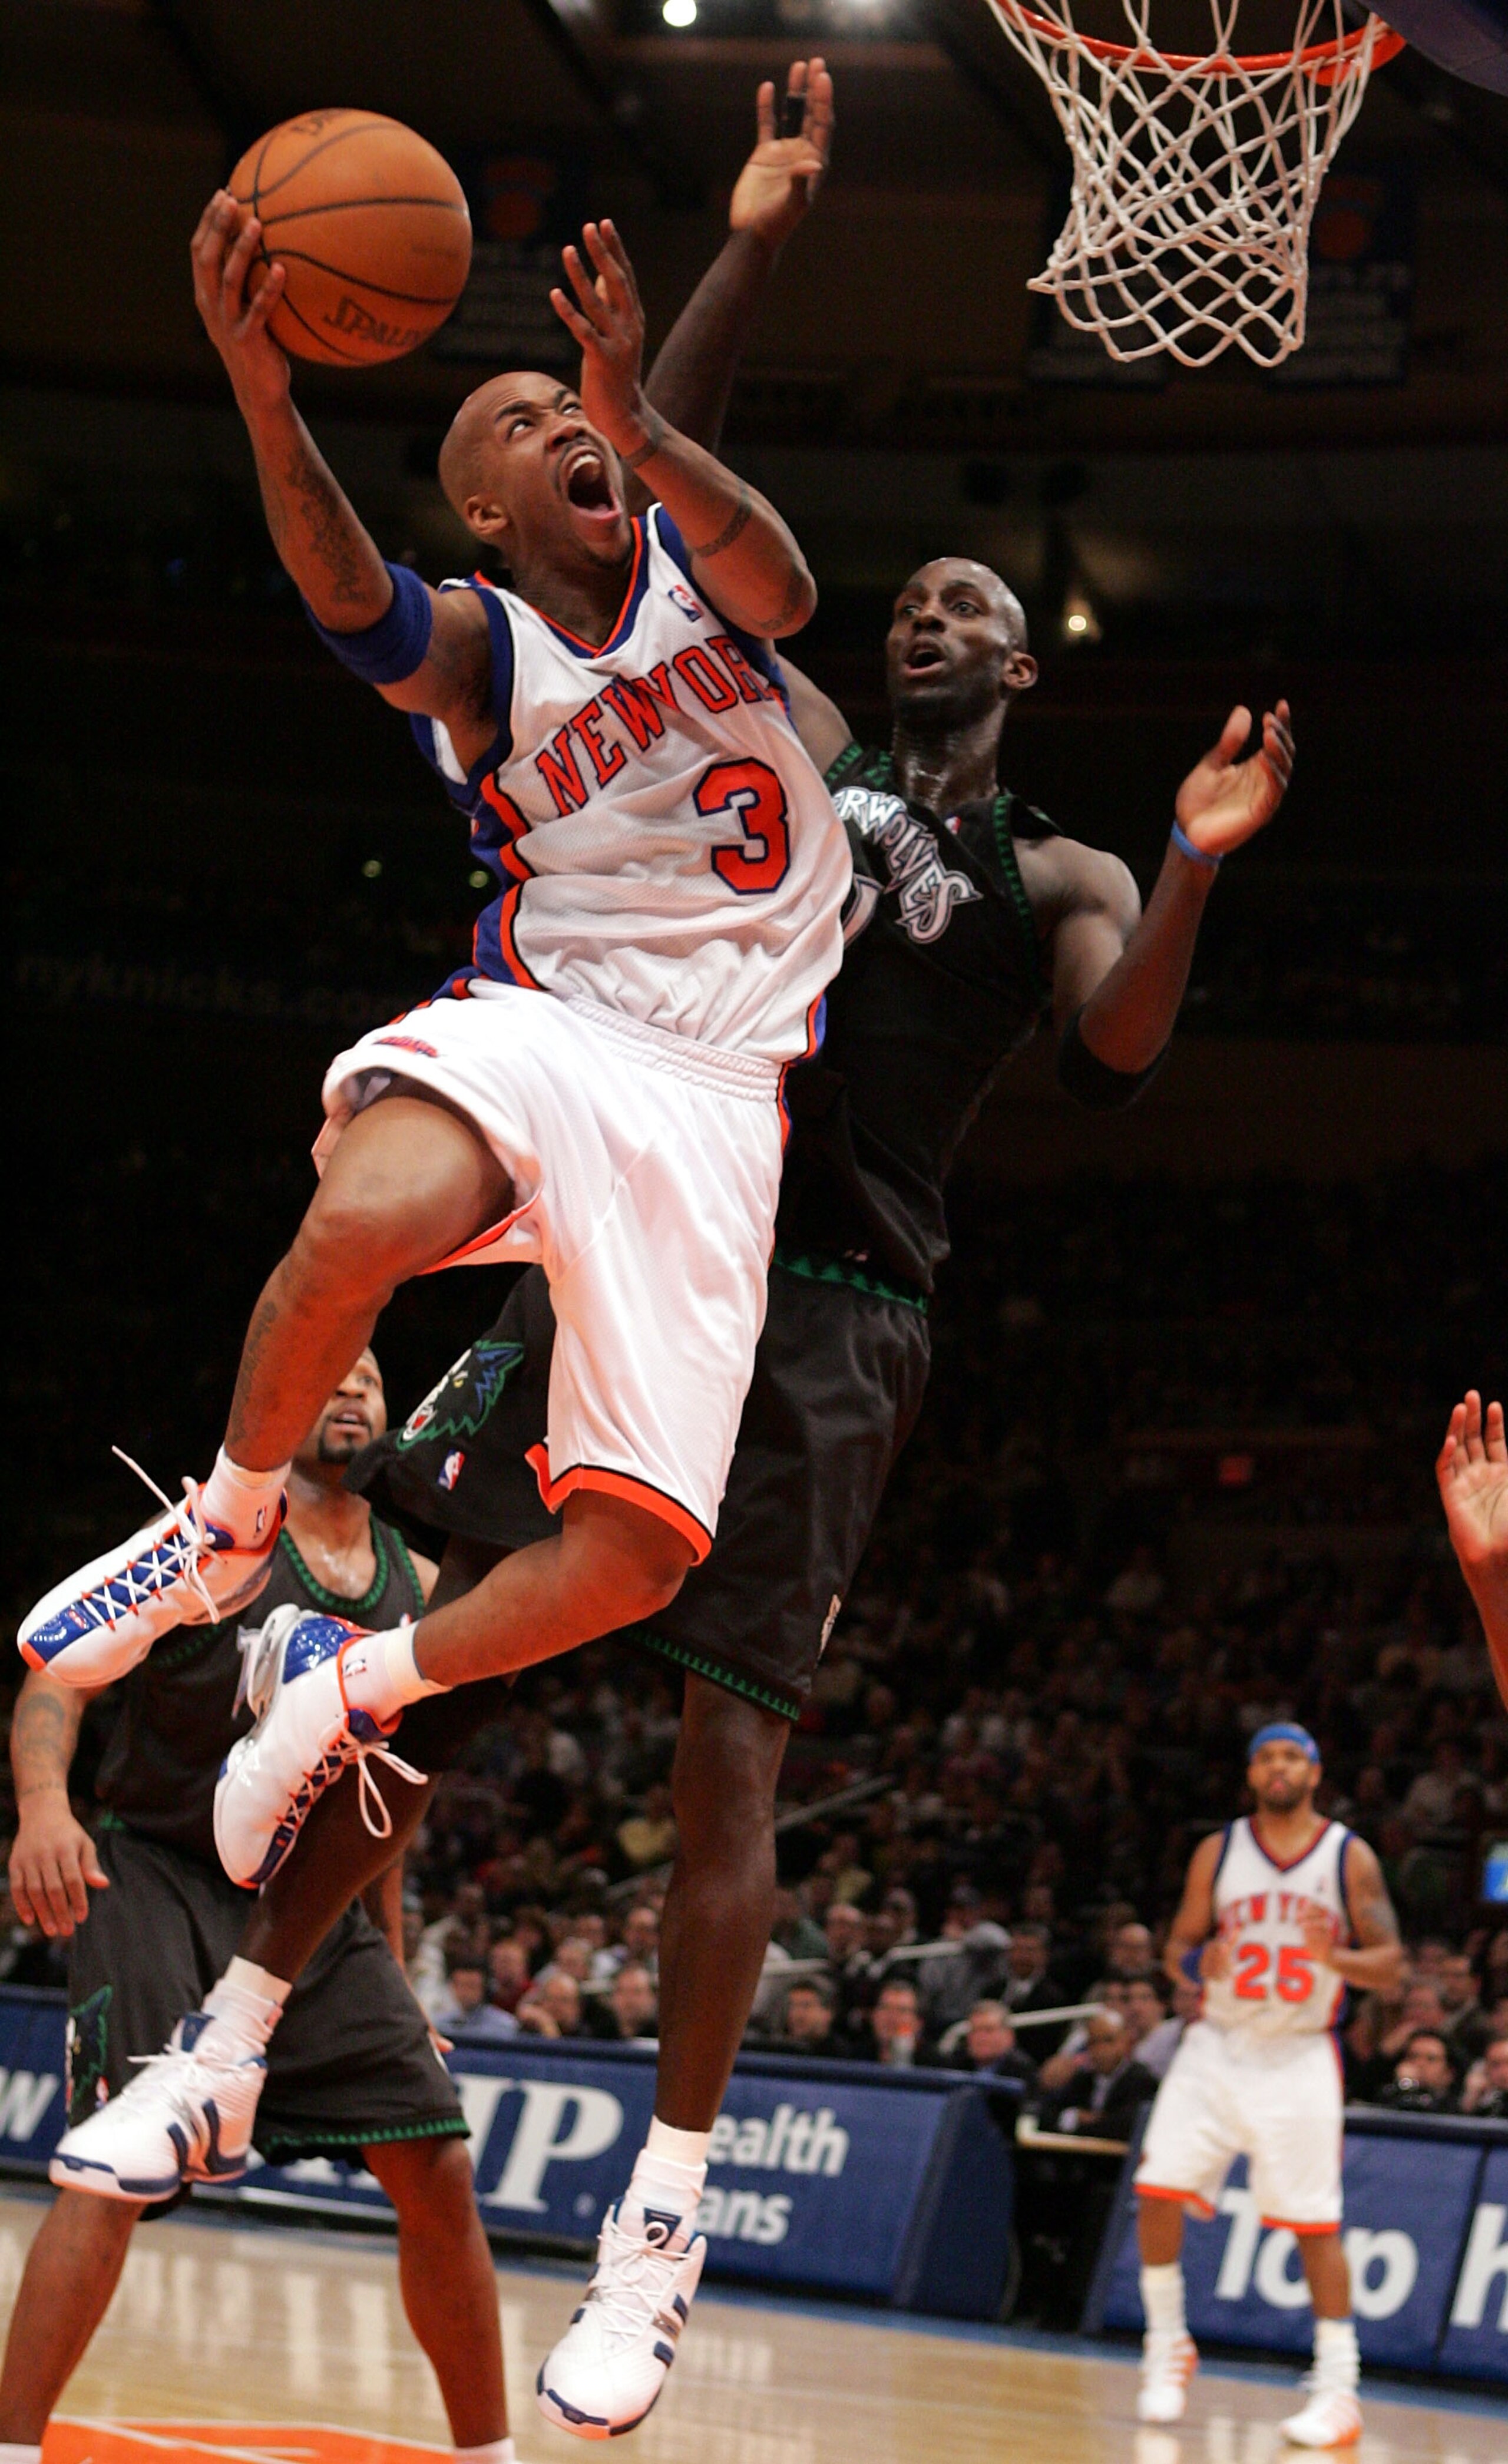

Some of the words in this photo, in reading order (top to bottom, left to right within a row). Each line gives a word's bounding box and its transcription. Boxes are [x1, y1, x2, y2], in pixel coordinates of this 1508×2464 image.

[535, 673, 666, 819] NEW
[646, 636, 776, 715] YOR
[692, 756, 791, 895] 3
[1234, 1944, 1313, 2003] 25
[707, 2102, 849, 2178] ealth
[695, 2185, 793, 2245] ans
[1215, 2187, 1418, 2321] Top
